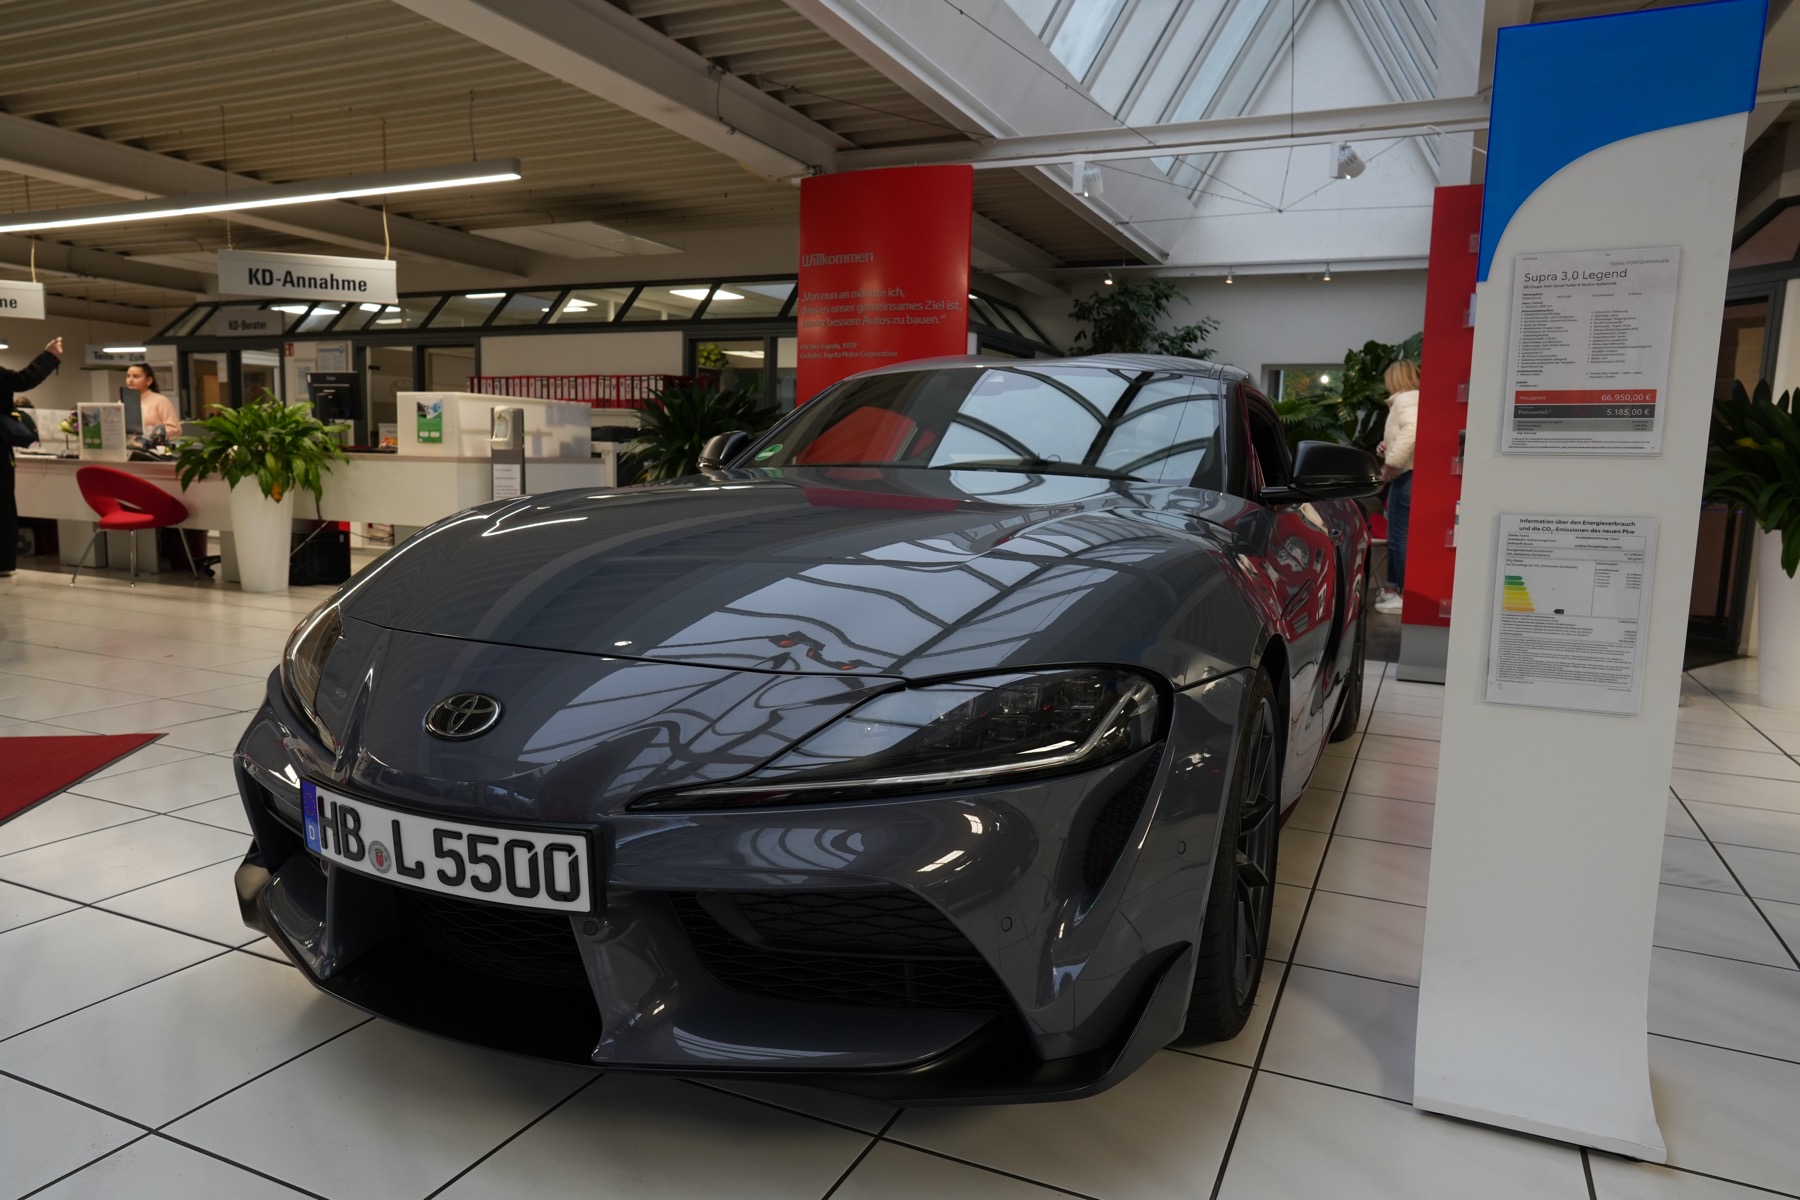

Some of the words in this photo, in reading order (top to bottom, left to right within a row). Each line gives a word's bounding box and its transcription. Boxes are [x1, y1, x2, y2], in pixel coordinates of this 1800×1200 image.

[802, 252, 873, 267] Willkommen
[248, 268, 367, 292] KD-Annahme
[1524, 272, 1557, 283] Supra
[1561, 271, 1579, 281] 3,0
[1583, 269, 1628, 281] Legend
[888, 288, 905, 298] ich,
[857, 302, 923, 313] gemeinsames
[925, 300, 944, 310] Ziel
[228, 320, 267, 330] KD-Berater
[827, 318, 862, 326] bessere
[863, 316, 890, 325] Autos
[892, 316, 904, 324] zu
[1606, 408, 1642, 416] 5.185,00
[308, 824, 316, 840] D
[317, 795, 366, 862] HB
[391, 819, 425, 880] L
[432, 828, 581, 902] 5500
